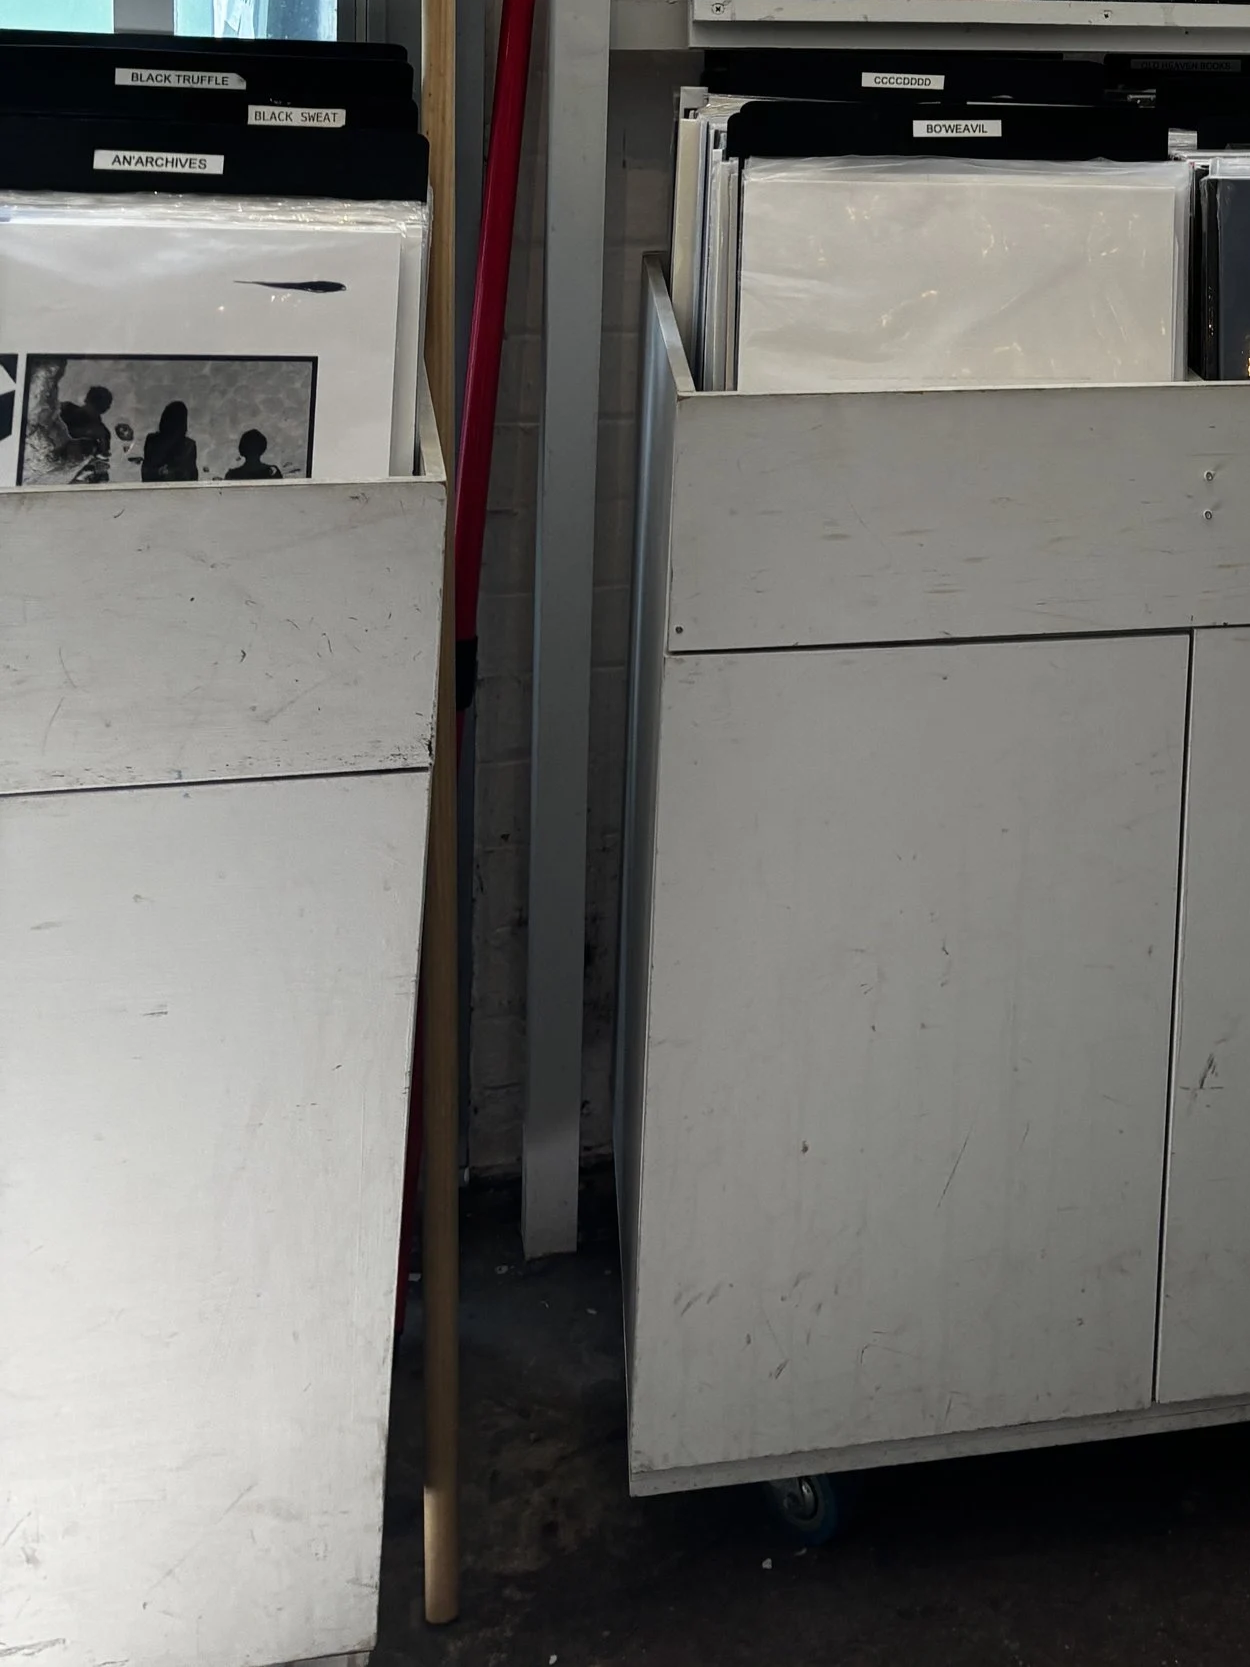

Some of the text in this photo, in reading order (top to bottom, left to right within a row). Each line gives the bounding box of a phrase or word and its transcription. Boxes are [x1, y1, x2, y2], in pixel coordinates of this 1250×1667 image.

[1163, 61, 1199, 71] HEAVEN
[1201, 61, 1231, 72] BOOKS
[131, 72, 229, 86] BLACK TRUFFLE
[874, 76, 932, 86] CCCCDDDD
[254, 111, 338, 123] BLACK SWEAT
[926, 124, 988, 134] BO'WEAVIL
[112, 155, 207, 170] AN'ARCHIVES
